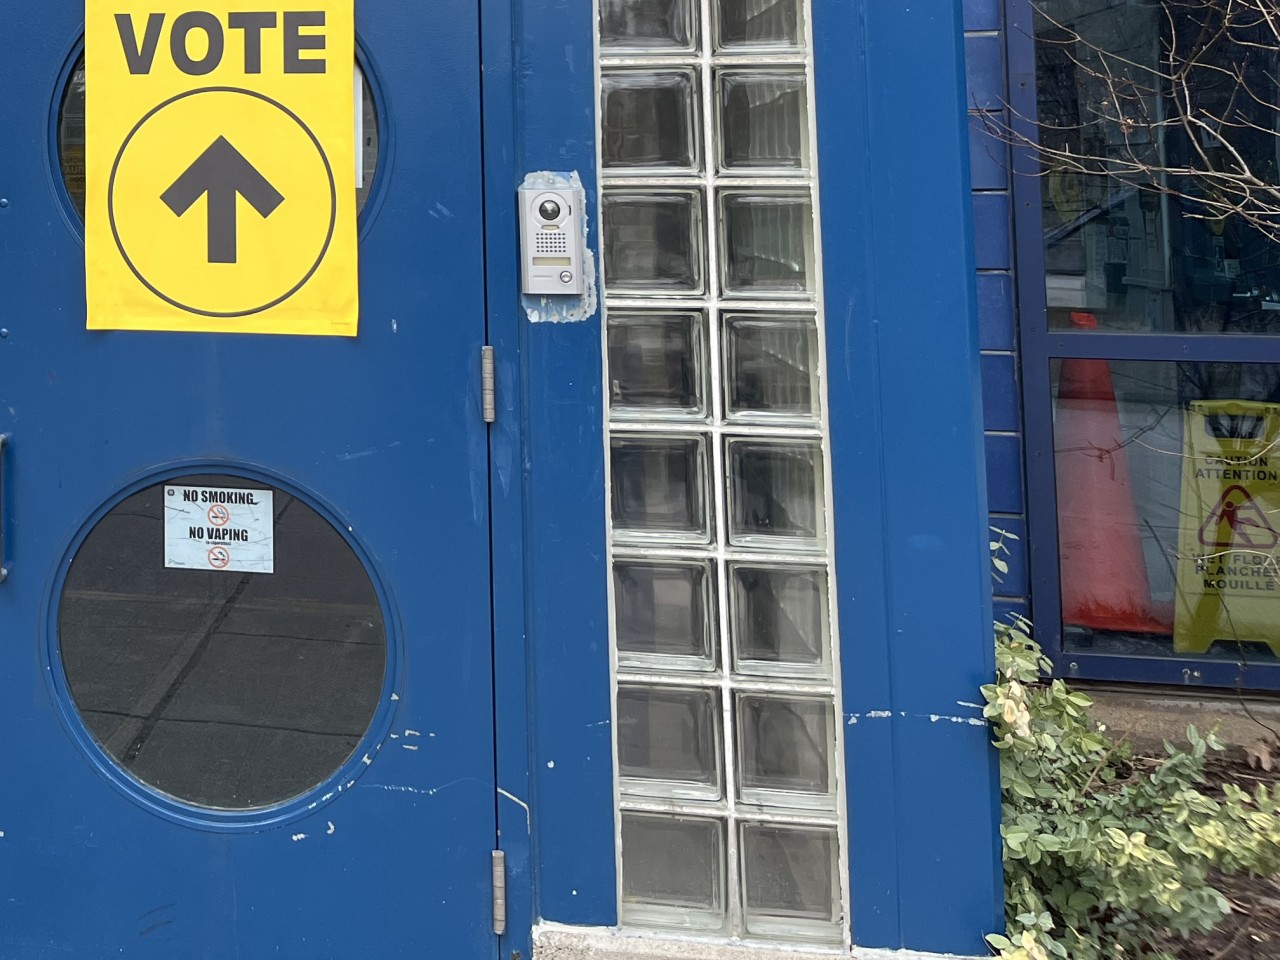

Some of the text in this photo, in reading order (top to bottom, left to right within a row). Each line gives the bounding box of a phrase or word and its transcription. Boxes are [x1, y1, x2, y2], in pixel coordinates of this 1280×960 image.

[113, 10, 326, 76] VOTE
[1204, 454, 1268, 467] CAUTION
[1195, 468, 1278, 481] ATTENTION
[183, 489, 254, 505] NO SMOKING
[189, 526, 248, 542] NO VAPING
